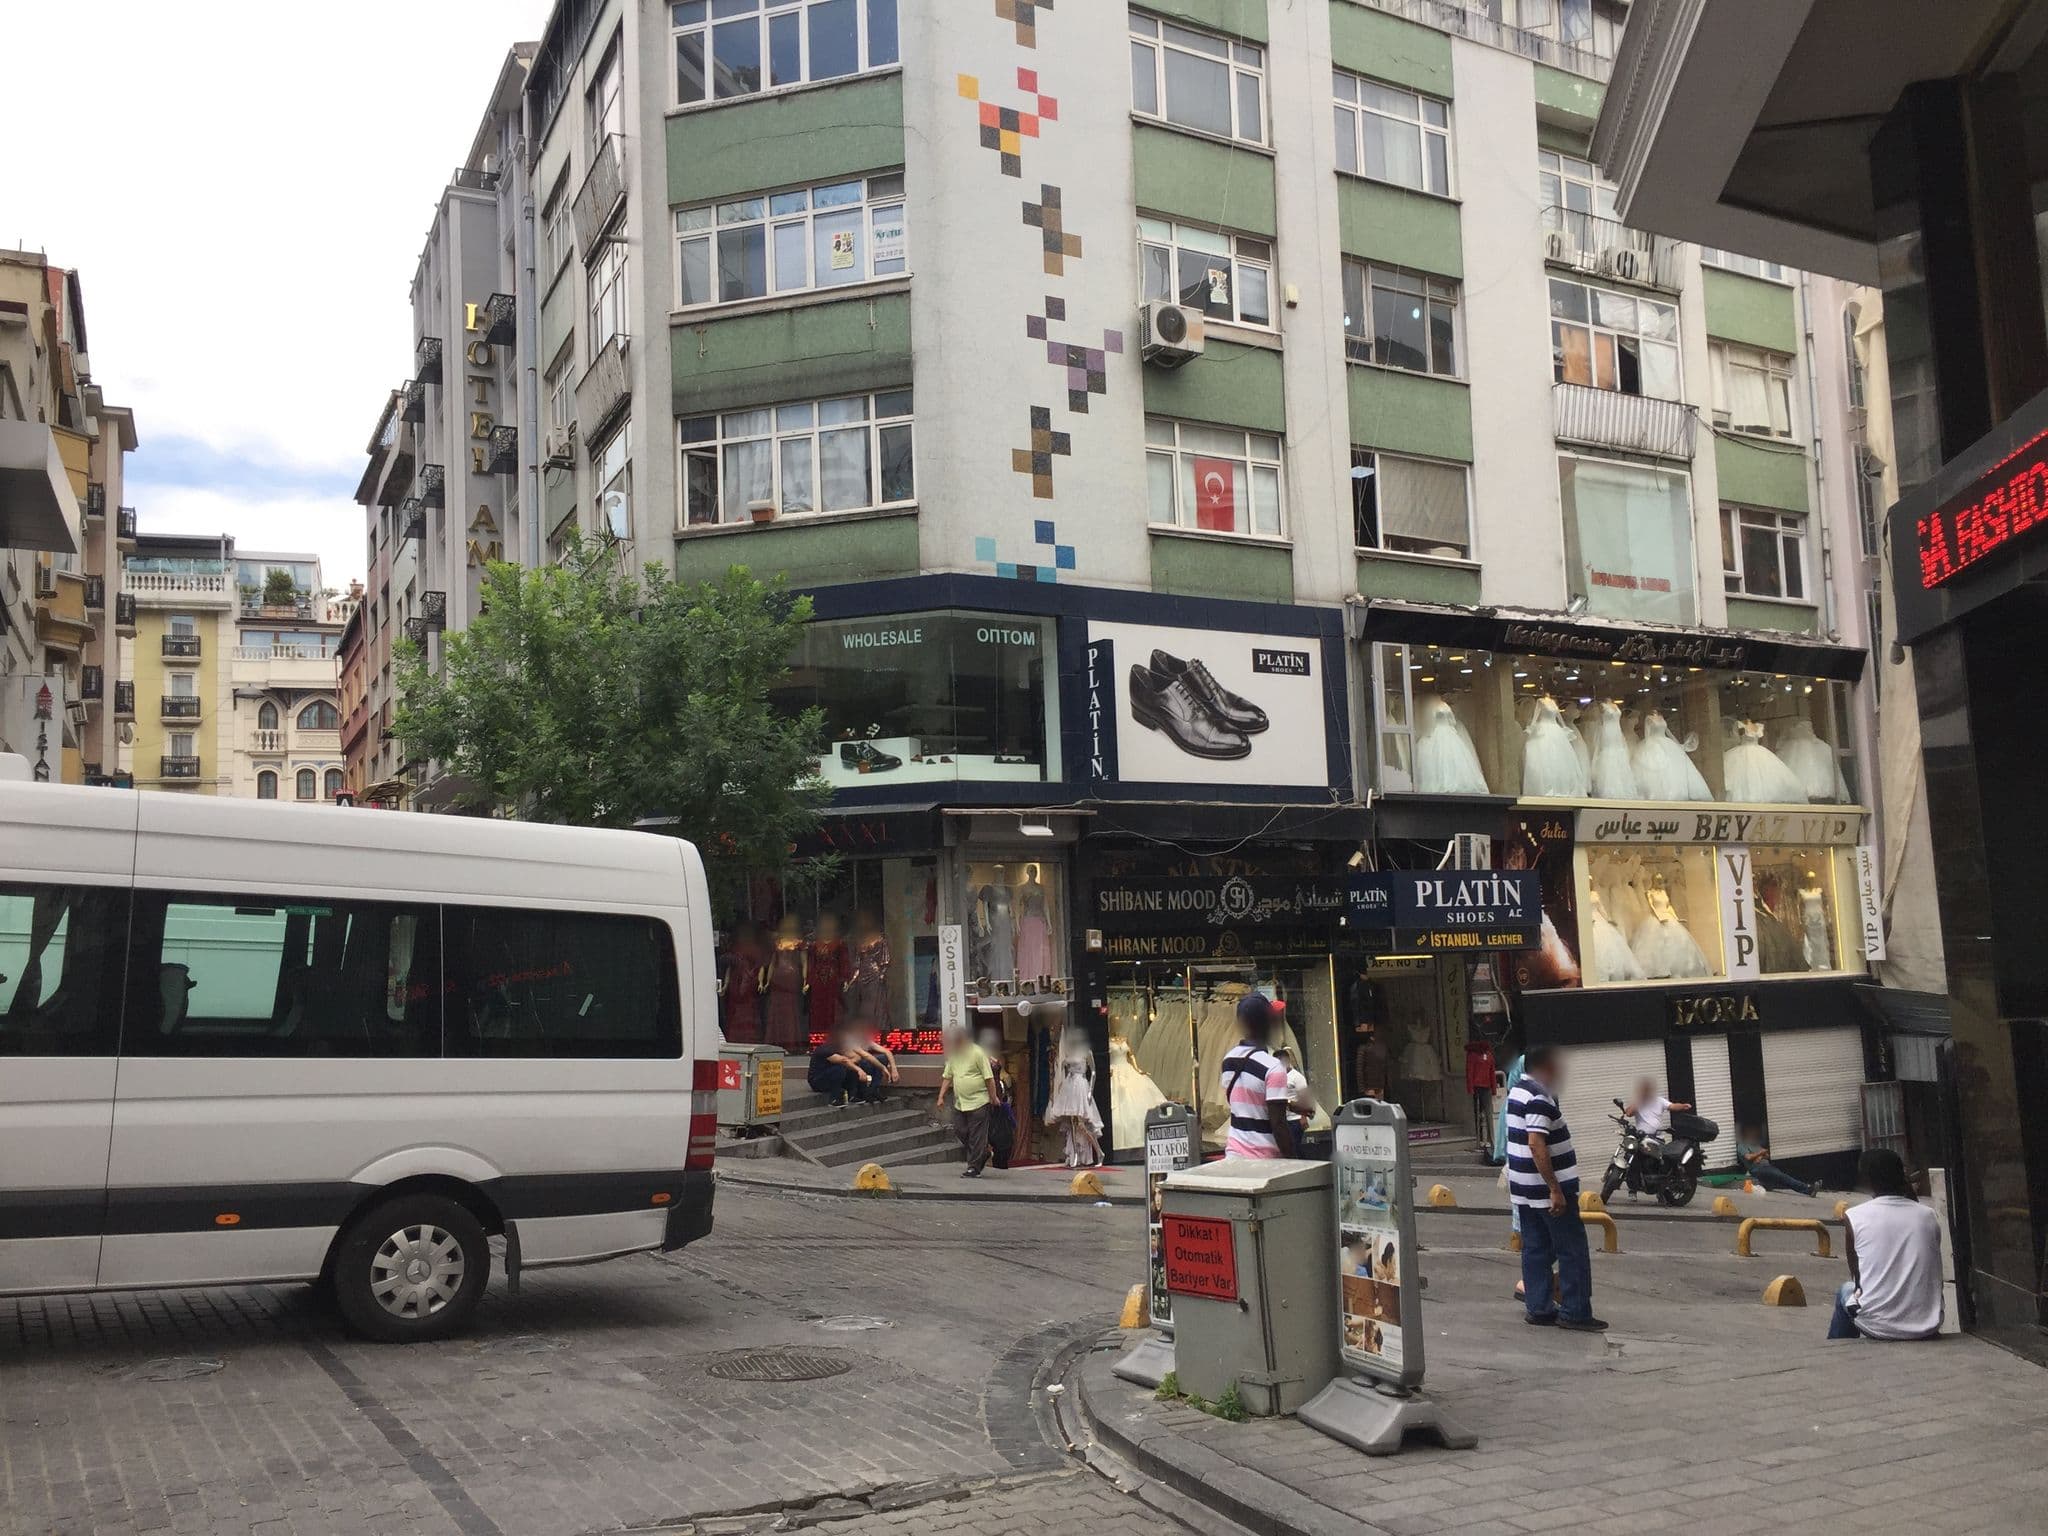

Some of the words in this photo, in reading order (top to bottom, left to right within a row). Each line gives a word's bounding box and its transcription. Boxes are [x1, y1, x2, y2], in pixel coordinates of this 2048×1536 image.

[843, 628, 922, 649] WHOLESALE
[1259, 653, 1304, 668] PLATİN
[1594, 812, 1642, 841] عباس
[1646, 821, 1681, 840] سيد
[1692, 814, 1790, 842] BEYAZ
[1168, 888, 1216, 911] MOOD
[1414, 871, 1523, 908] PLATİN
[1447, 911, 1495, 924] SHOES
[1161, 935, 1206, 955] MOOD
[1487, 933, 1524, 946] LEATHER
[1178, 1223, 1213, 1241] Dikkat
[1175, 1246, 1224, 1265] Otomatik
[1170, 1268, 1210, 1289] Bariyer
